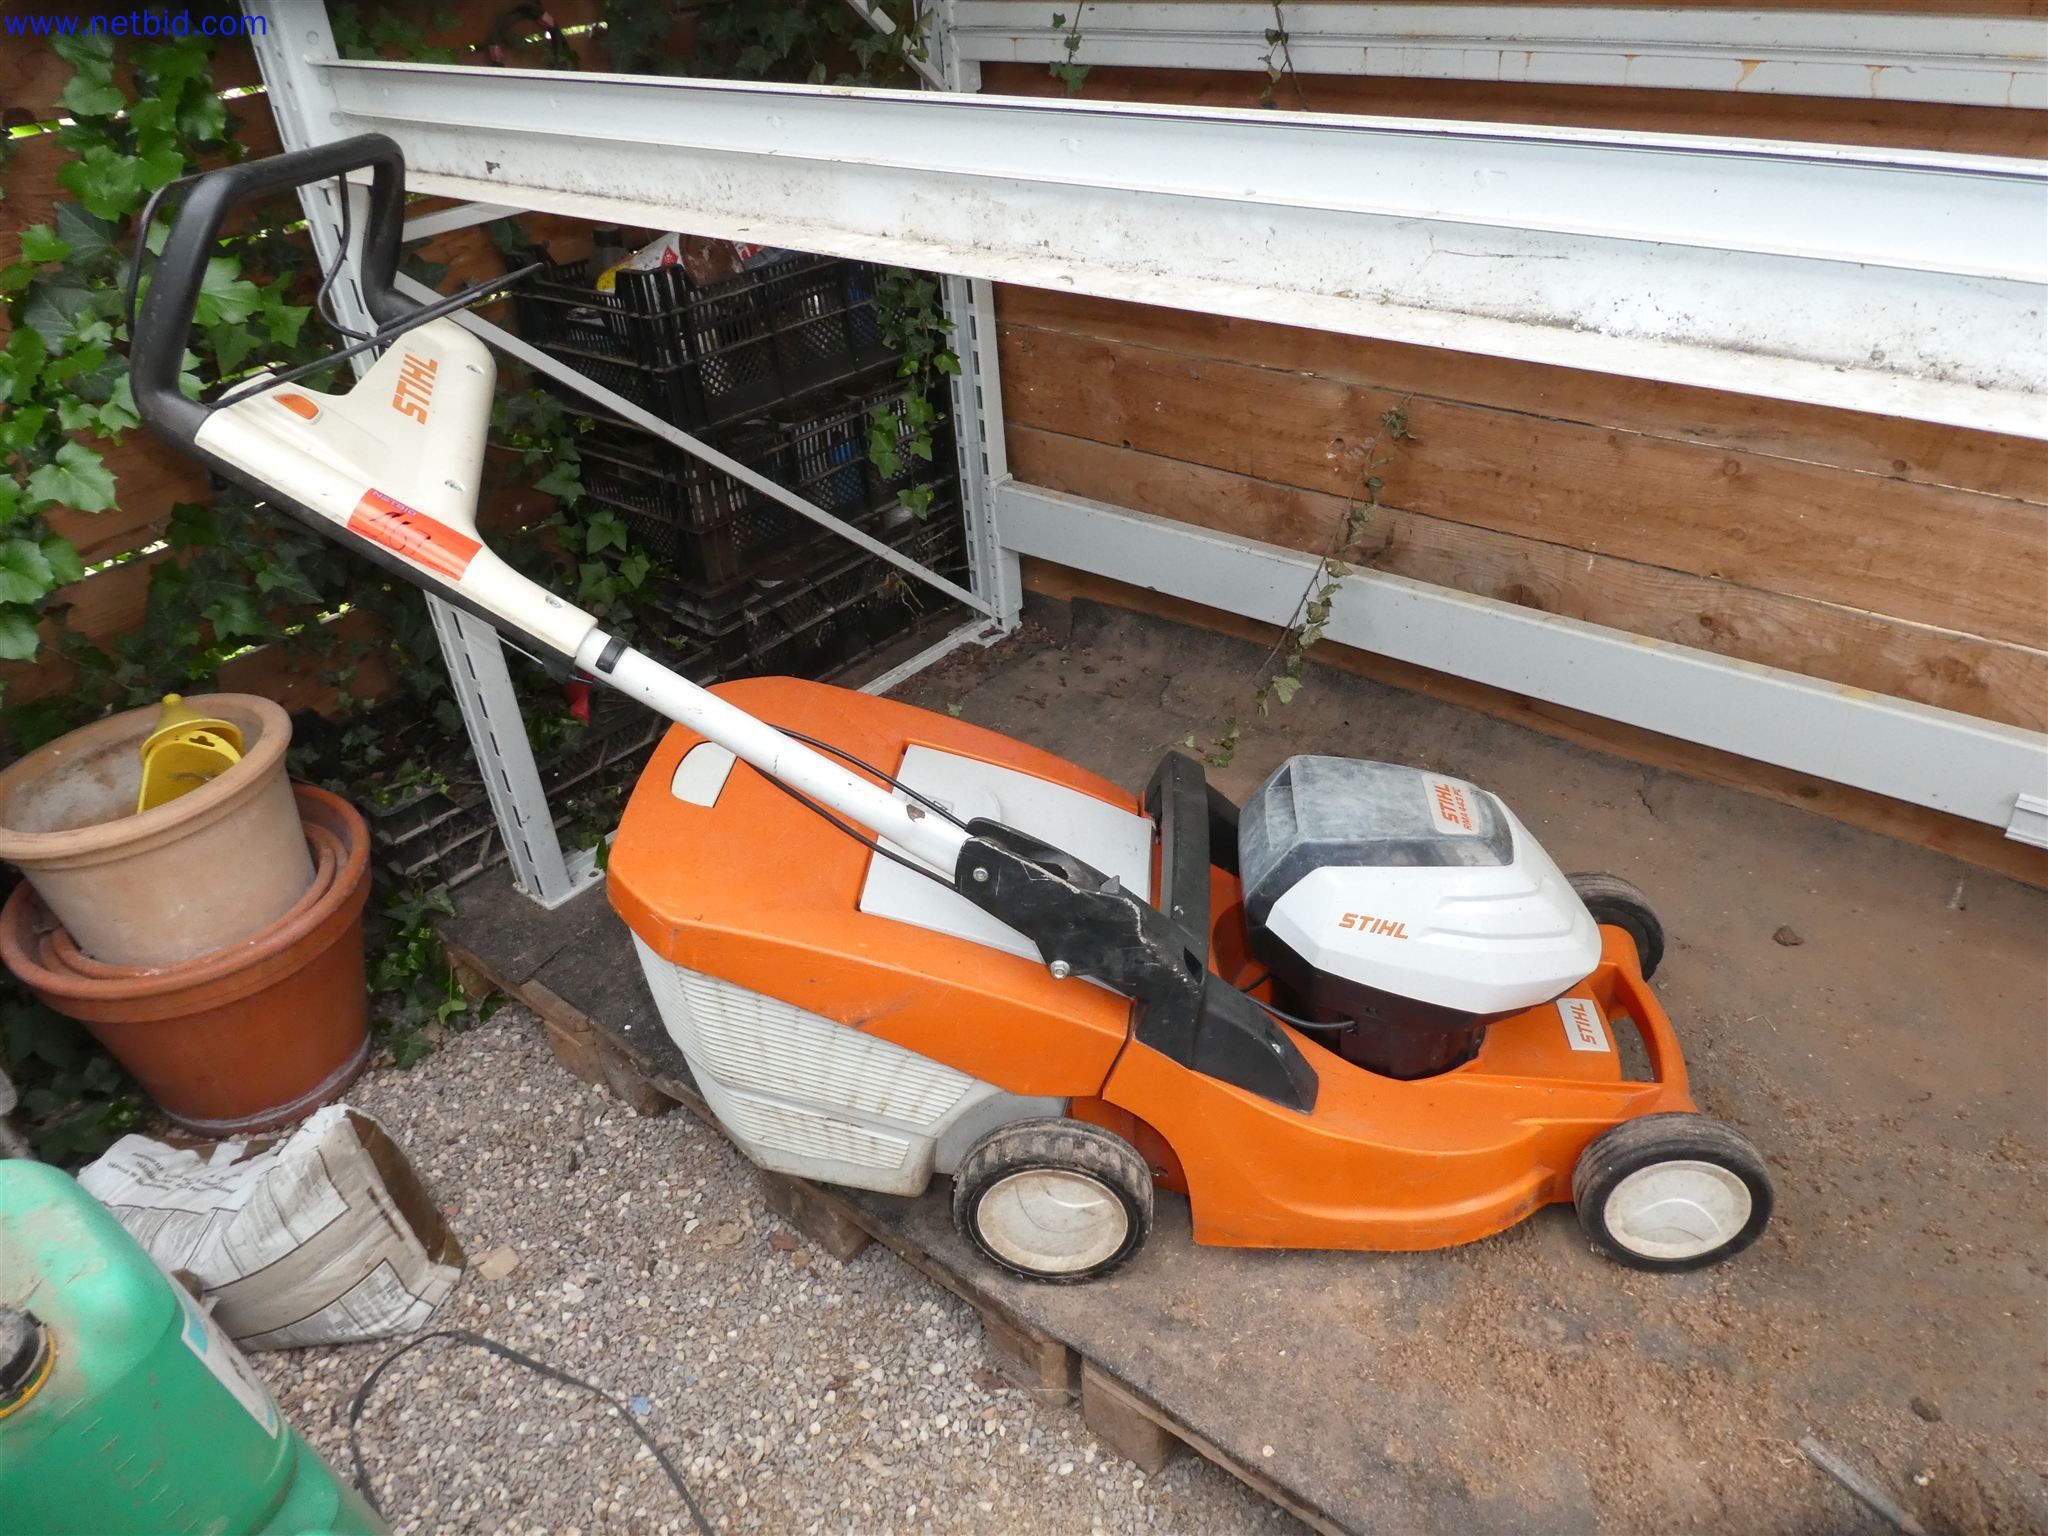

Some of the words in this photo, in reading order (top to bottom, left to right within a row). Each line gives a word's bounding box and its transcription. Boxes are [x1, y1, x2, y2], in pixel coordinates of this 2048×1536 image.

[392, 353, 438, 425] STIHL
[372, 489, 417, 516] NETBID
[1434, 784, 1460, 824] STIHL
[1461, 812, 1473, 831] RMA
[1338, 912, 1409, 940] STIHL
[1570, 1003, 1597, 1045] STIHL
